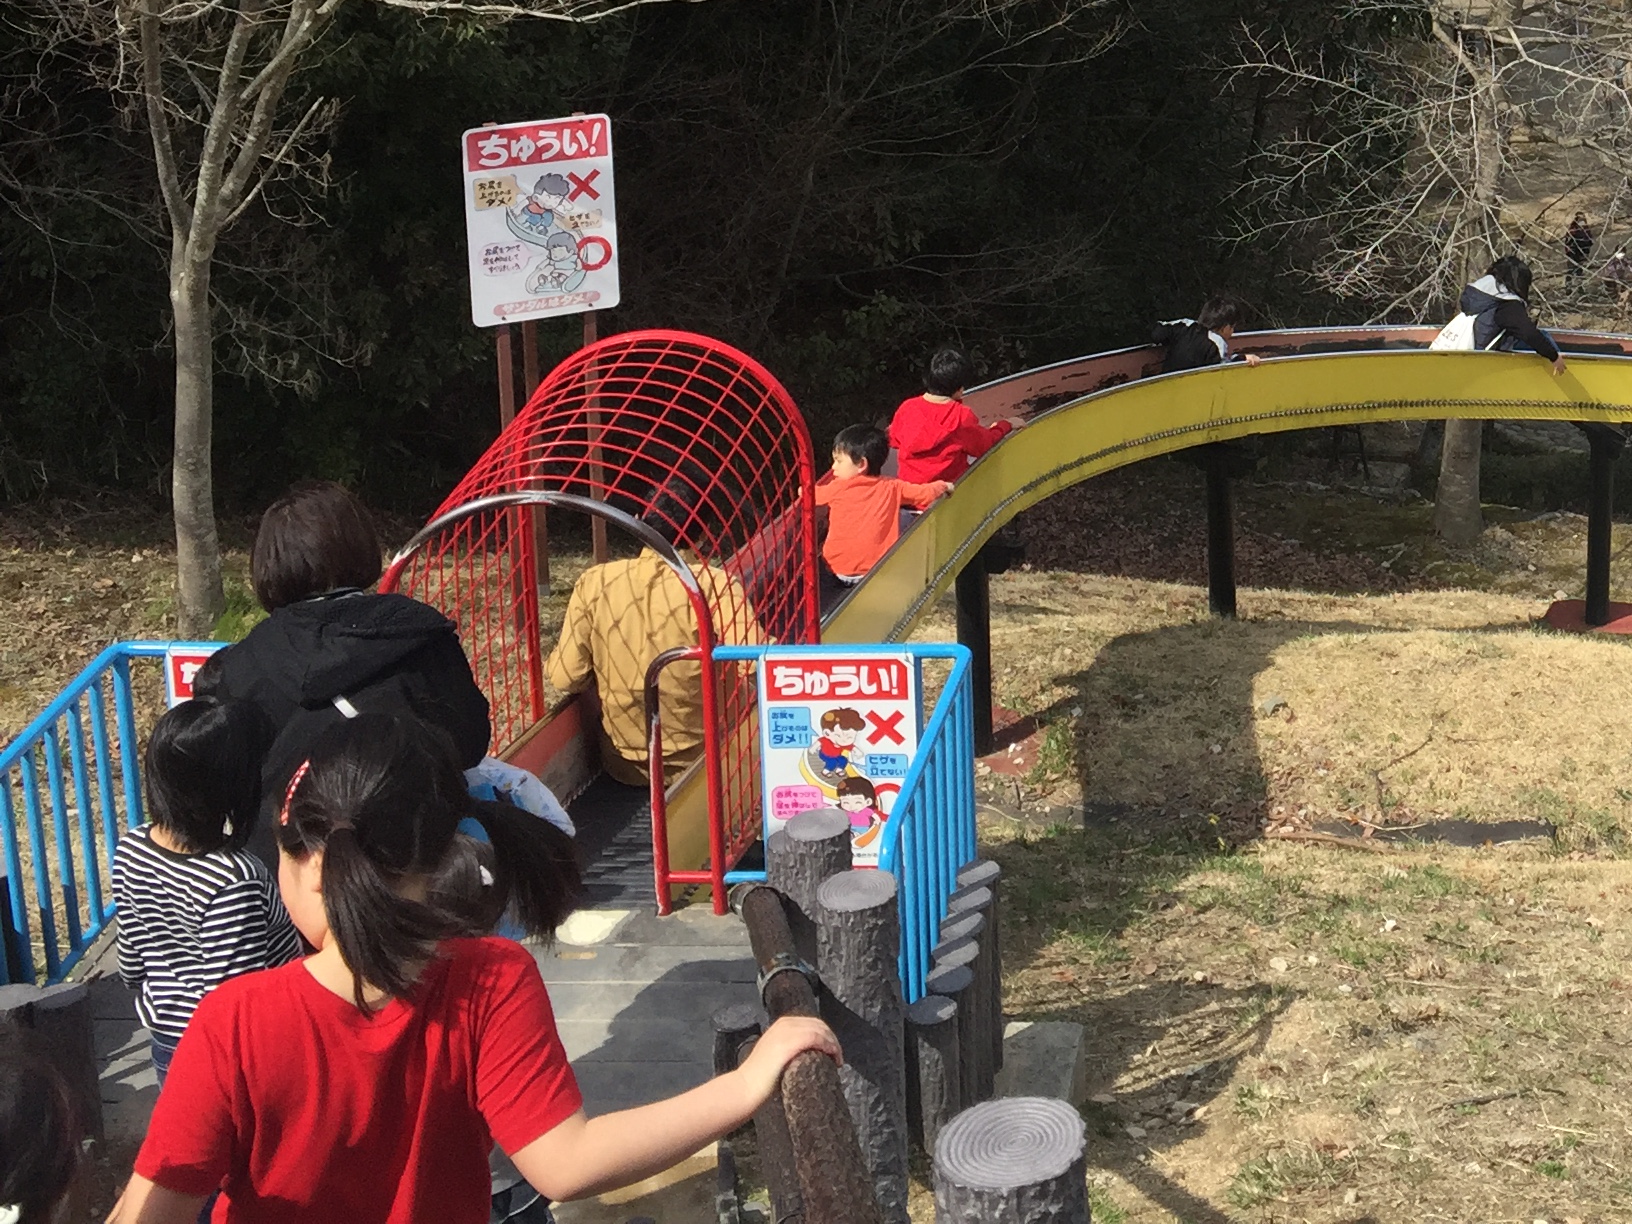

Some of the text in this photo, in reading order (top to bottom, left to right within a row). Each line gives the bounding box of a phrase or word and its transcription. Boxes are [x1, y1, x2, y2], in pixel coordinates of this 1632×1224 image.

[477, 121, 602, 167] ちゅうい!
[772, 663, 900, 697] ちゅうい!
